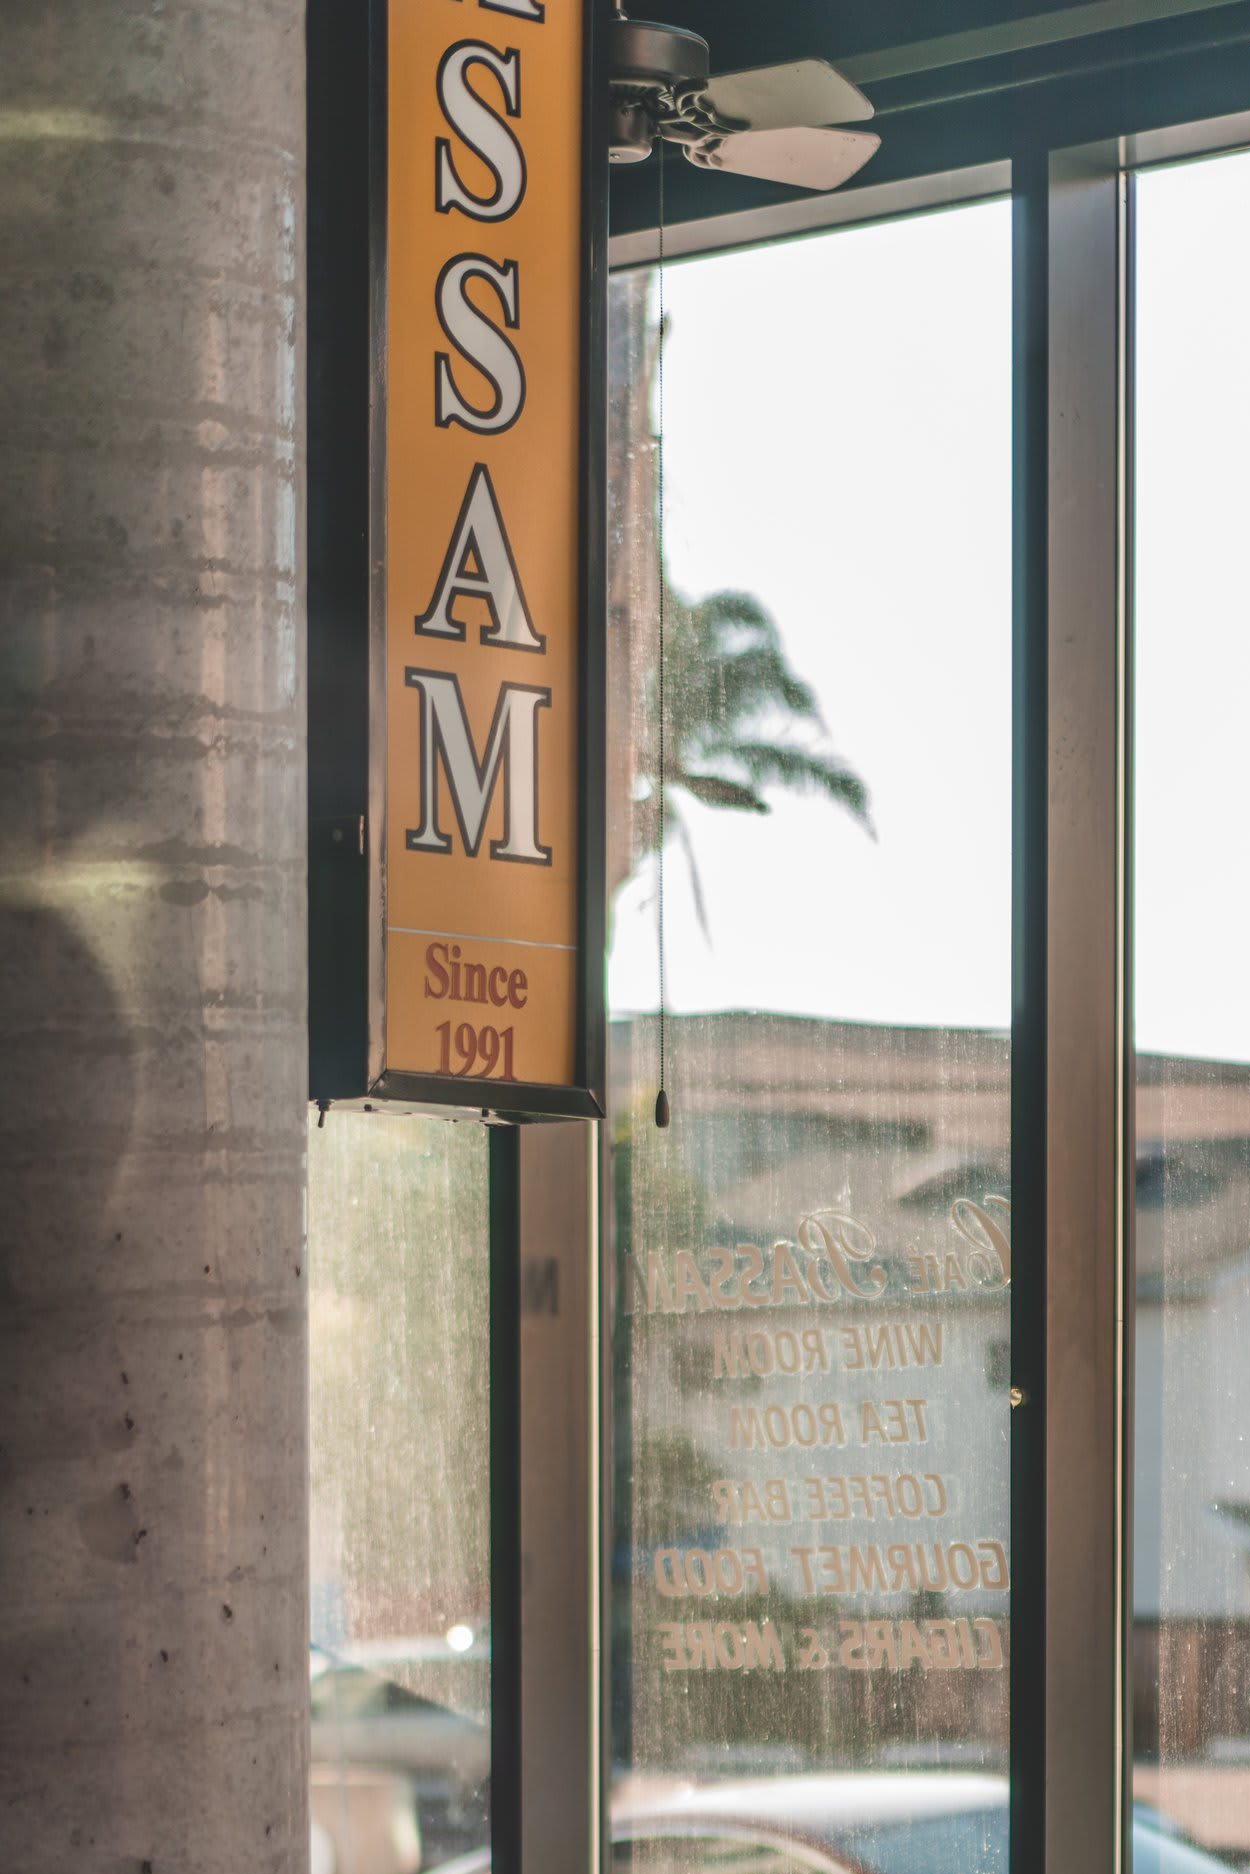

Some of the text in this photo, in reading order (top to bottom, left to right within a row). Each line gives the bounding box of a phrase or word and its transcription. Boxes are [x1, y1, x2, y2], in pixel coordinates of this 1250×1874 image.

[404, 0, 553, 868] SSAM
[423, 941, 530, 1010] Since
[434, 1019, 518, 1082] 1991
